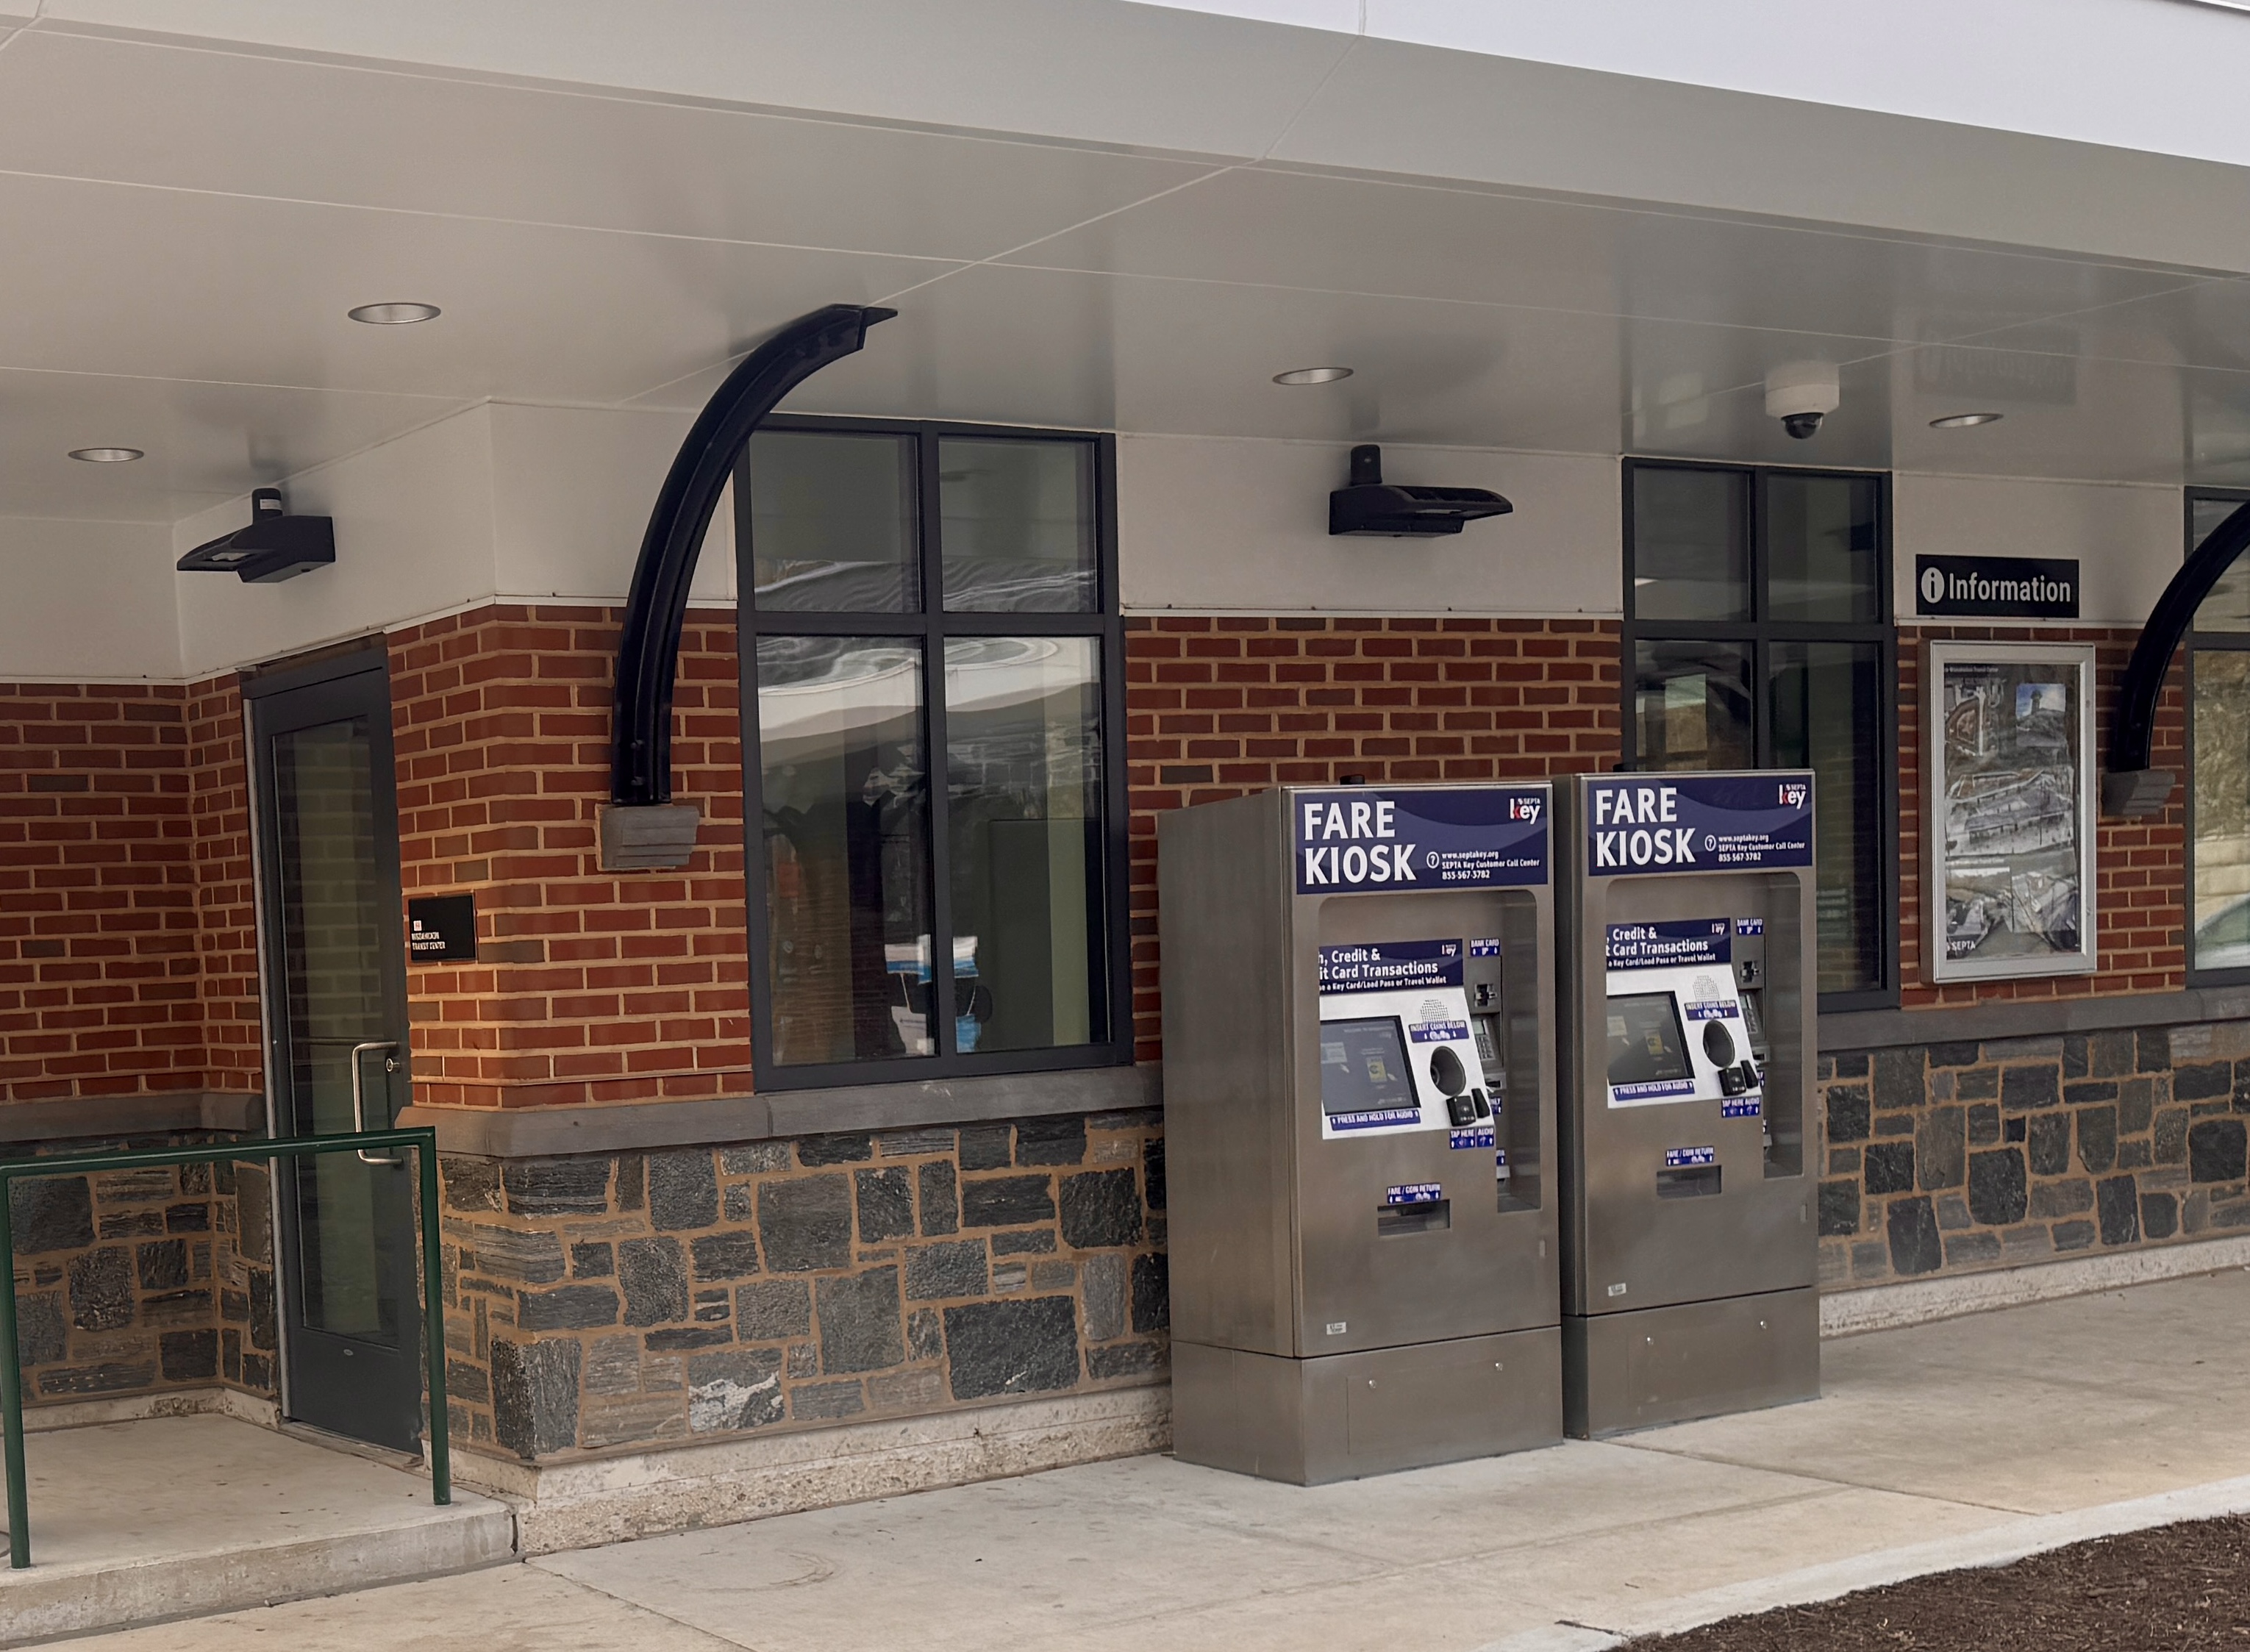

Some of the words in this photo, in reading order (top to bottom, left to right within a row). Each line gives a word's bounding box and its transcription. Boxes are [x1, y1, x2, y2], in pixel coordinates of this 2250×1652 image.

[1949, 572, 2071, 602] Information
[1510, 798, 1540, 824] key
[1596, 787, 1677, 825] FARE
[1304, 801, 1396, 840] FARE
[1442, 851, 1499, 859] www.septakey.org
[1596, 828, 1696, 867] KIOSK
[1718, 844, 1736, 852] SEPTA
[1738, 844, 1747, 853] Key
[1304, 844, 1417, 884] KIOSK
[1442, 862, 1461, 870] SEPTA
[1463, 861, 1474, 870] Key
[1476, 859, 1505, 868] Customer
[1520, 859, 1540, 867] Center
[1613, 926, 1646, 941] Credit
[1649, 926, 1657, 940] &
[1613, 942, 1638, 956] Card
[1640, 938, 1708, 955] Transactions
[1951, 940, 1976, 951] SEPTA
[1332, 948, 1368, 963] Credit
[1371, 948, 1381, 961] &
[1678, 954, 1696, 962] Travel
[1697, 953, 1715, 961] Wallet
[1332, 965, 1358, 979] Card
[1362, 960, 1438, 977] Transactions
[1332, 983, 1344, 991] Key
[1379, 979, 1394, 987] Pass
[1404, 976, 1424, 986] Travel
[1425, 976, 1446, 984] Wallet
